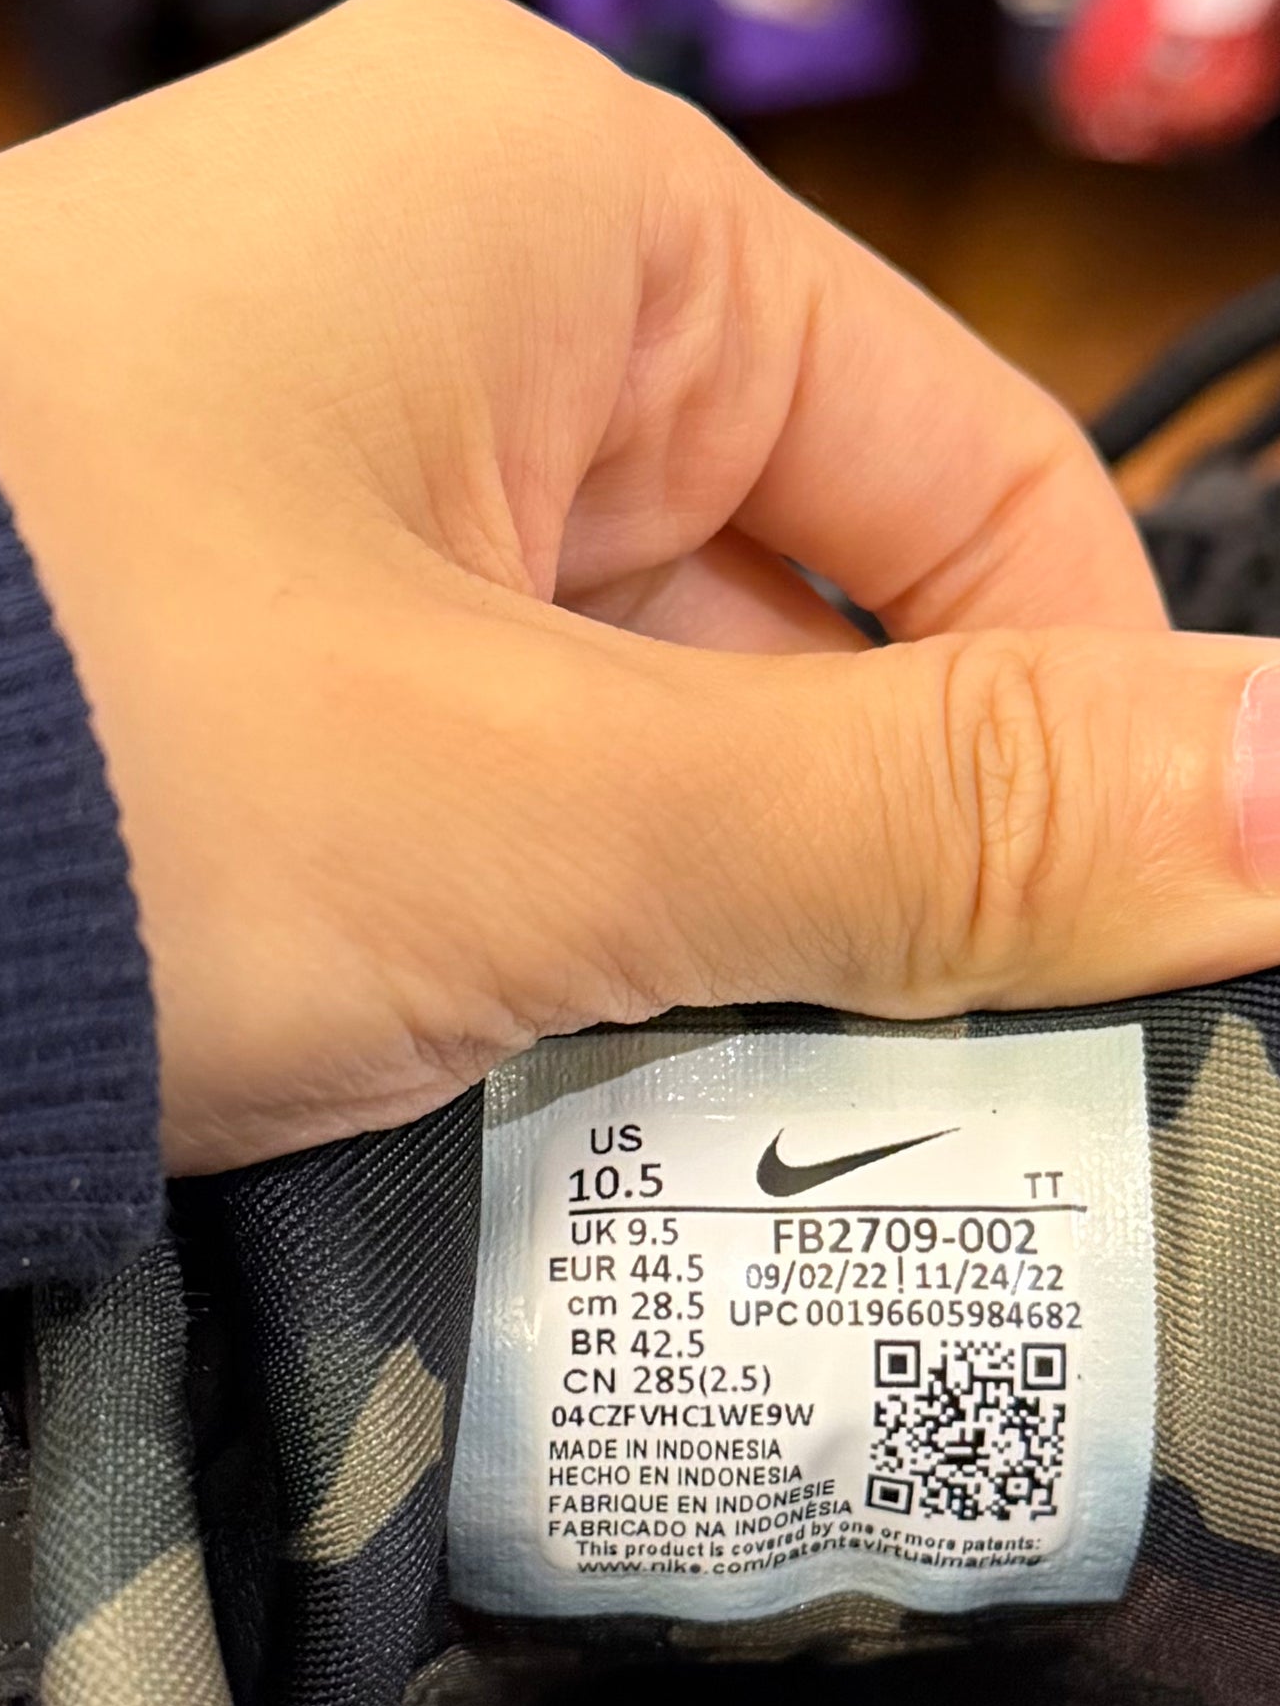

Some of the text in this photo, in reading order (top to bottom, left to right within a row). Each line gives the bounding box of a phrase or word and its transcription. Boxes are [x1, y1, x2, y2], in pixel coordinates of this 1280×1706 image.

[590, 1124, 643, 1155] US
[568, 1163, 664, 1203] 10.5
[1023, 1171, 1064, 1199] TT
[571, 1217, 679, 1246] UK 9.5
[773, 1217, 1039, 1255] FB2709-002
[549, 1254, 704, 1283] EUR 44.5
[567, 1291, 705, 1321] cm 28.5
[729, 1299, 1084, 1330] UPC 00196605984682
[571, 1328, 706, 1358] BR 42.5
[563, 1364, 772, 1398] CN 285(2.5)
[549, 1439, 783, 1461] MADE IN INDONESIA
[549, 1465, 803, 1488] HECHO EN INDONESIA
[548, 1479, 836, 1515] FABRIQUE EN INDONESIE
[548, 1520, 686, 1538] FABRICADO
[695, 1520, 727, 1539] NA
[577, 1541, 618, 1557] This
[624, 1540, 704, 1562] product
[709, 1541, 723, 1557] is
[731, 1523, 806, 1556] covered
[811, 1519, 833, 1538] by
[839, 1520, 874, 1535] one
[881, 1528, 902, 1541] or
[905, 1532, 956, 1551] more
